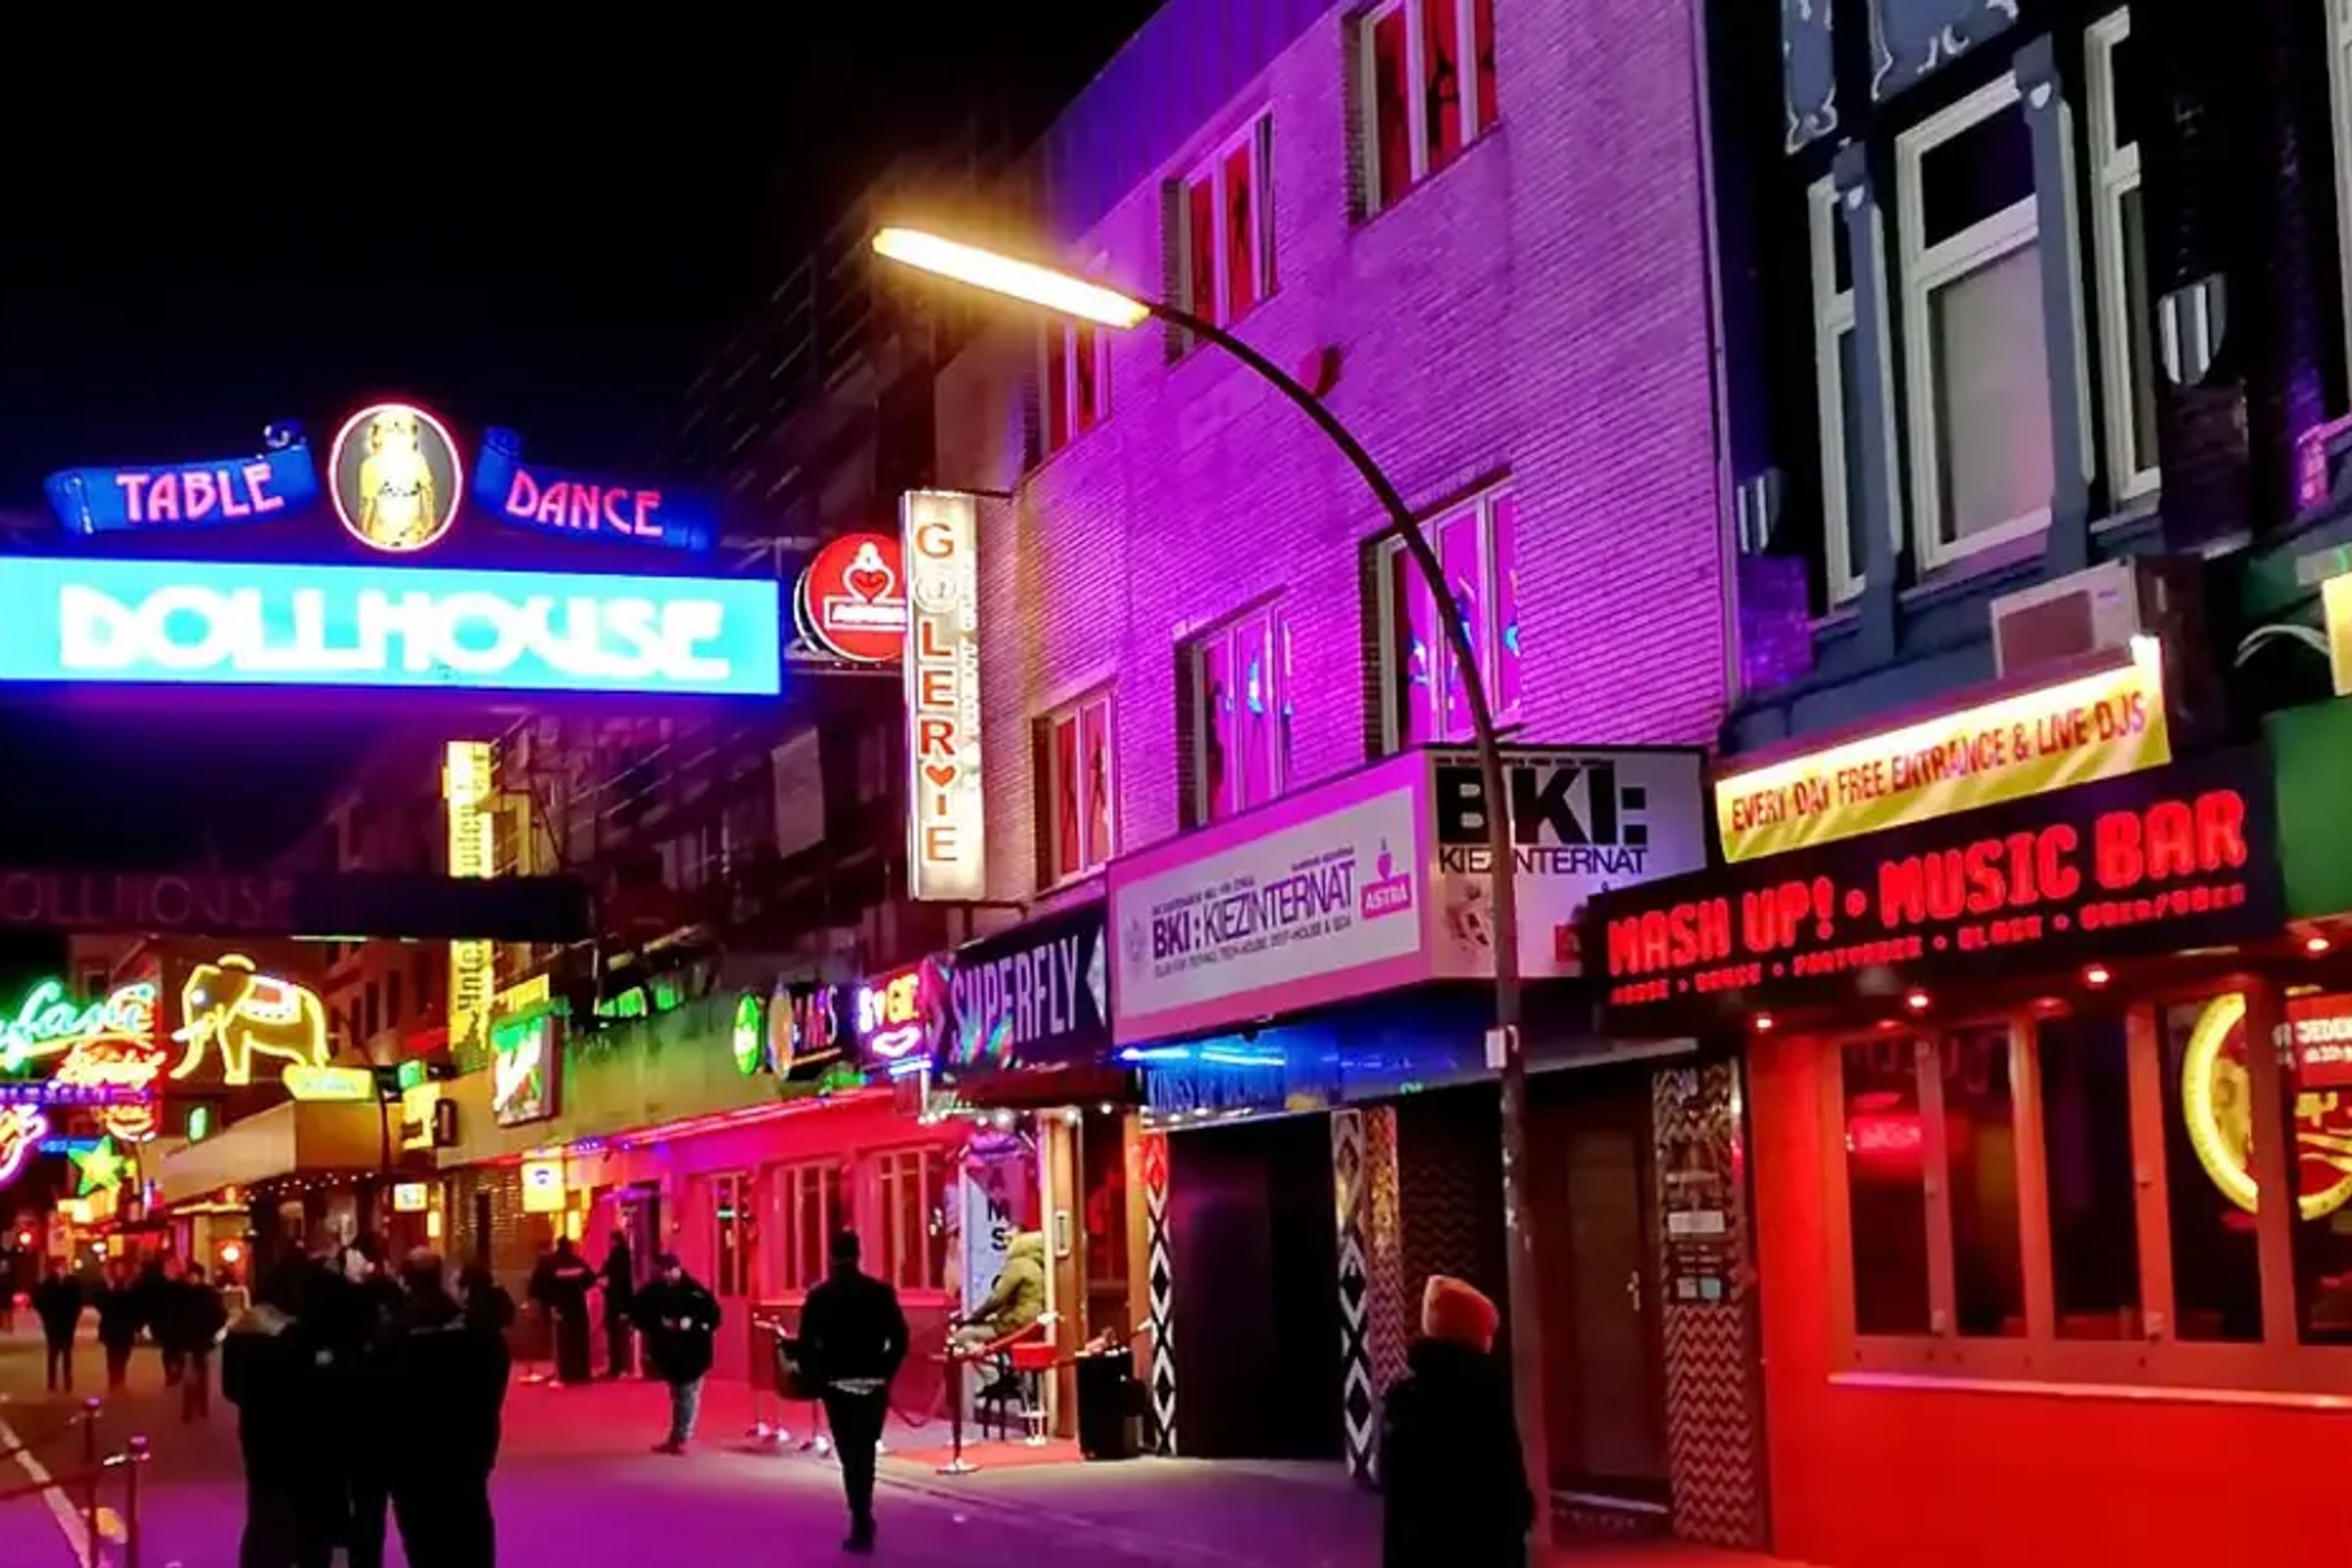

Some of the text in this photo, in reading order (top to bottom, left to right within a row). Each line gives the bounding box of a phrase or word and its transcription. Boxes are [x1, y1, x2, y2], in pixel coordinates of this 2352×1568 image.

[116, 463, 284, 523] TABLE
[505, 469, 663, 537] DANCE
[60, 583, 731, 681] DOLLHOUSE
[1732, 791, 1787, 832] EVERY
[1793, 780, 1831, 816] DAY
[1837, 760, 1885, 805] FREE
[1890, 727, 2006, 790] ENTRANCE
[2012, 723, 2030, 760] &
[2036, 707, 2088, 756] LIVE
[1439, 846, 1648, 874] KIENTERNAT
[1608, 788, 2247, 977] MASH UP! MUSIC BAR
[949, 934, 1079, 1063] SUPERFLY
